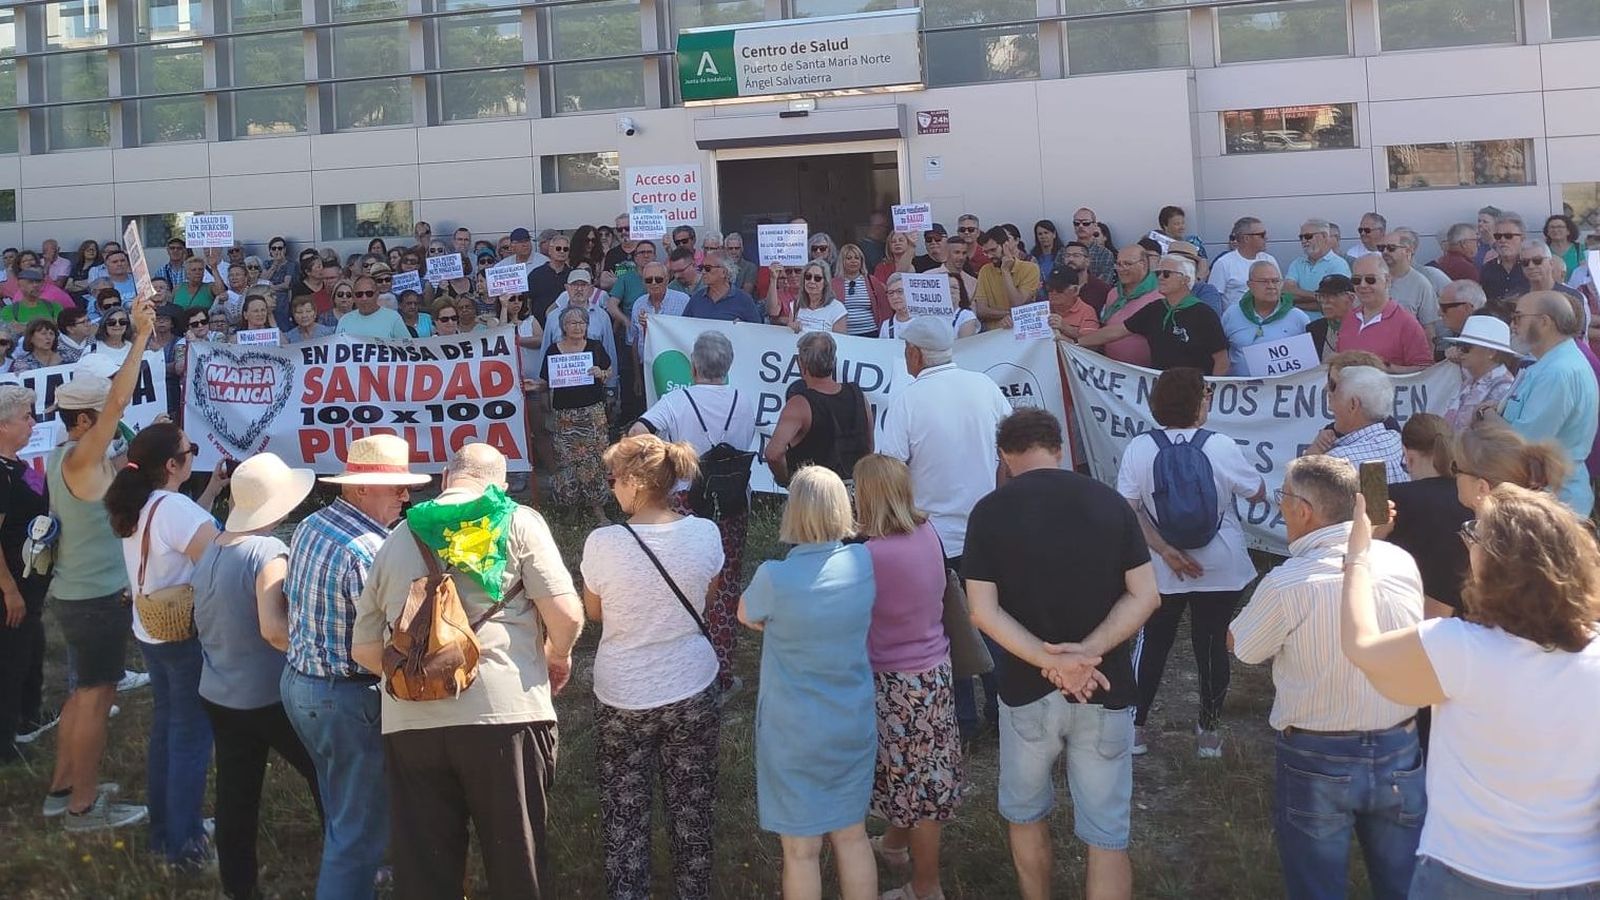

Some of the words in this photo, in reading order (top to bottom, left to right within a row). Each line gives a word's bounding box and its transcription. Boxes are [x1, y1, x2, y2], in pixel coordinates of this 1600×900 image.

[742, 45, 787, 59] Centro
[790, 42, 807, 55] de
[810, 37, 849, 53] Salud
[743, 63, 778, 75] Puerto
[780, 61, 794, 72] de
[796, 59, 826, 71] Santa
[828, 55, 858, 68] María
[860, 53, 892, 66] Norte
[745, 76, 774, 91] Ángel
[776, 73, 832, 87] Salvatierra
[932, 116, 949, 124] 24h
[635, 174, 680, 186] Acceso
[684, 171, 696, 183] al
[632, 191, 677, 204] Centro
[681, 189, 697, 202] de
[200, 216, 218, 224] SALUD
[907, 214, 925, 223] SALUD
[909, 279, 941, 288] DEFIENDE
[912, 293, 919, 302] TU
[920, 293, 942, 303] SALUD
[928, 306, 953, 315] PÚBLICA
[301, 344, 328, 365] EN
[335, 343, 438, 364] DEFENSA
[440, 341, 474, 360] DE
[480, 336, 510, 357] LA
[1268, 344, 1289, 359] NO
[207, 364, 275, 386] MAREA
[1267, 365, 1276, 376] A
[1279, 360, 1301, 373] LAS
[302, 360, 515, 405] SANIDAD
[1072, 358, 1126, 400] QUE
[208, 384, 273, 404] BLANCA
[301, 404, 384, 426] 100
[425, 400, 517, 423] 100
[298, 420, 523, 464] PÚLICA
